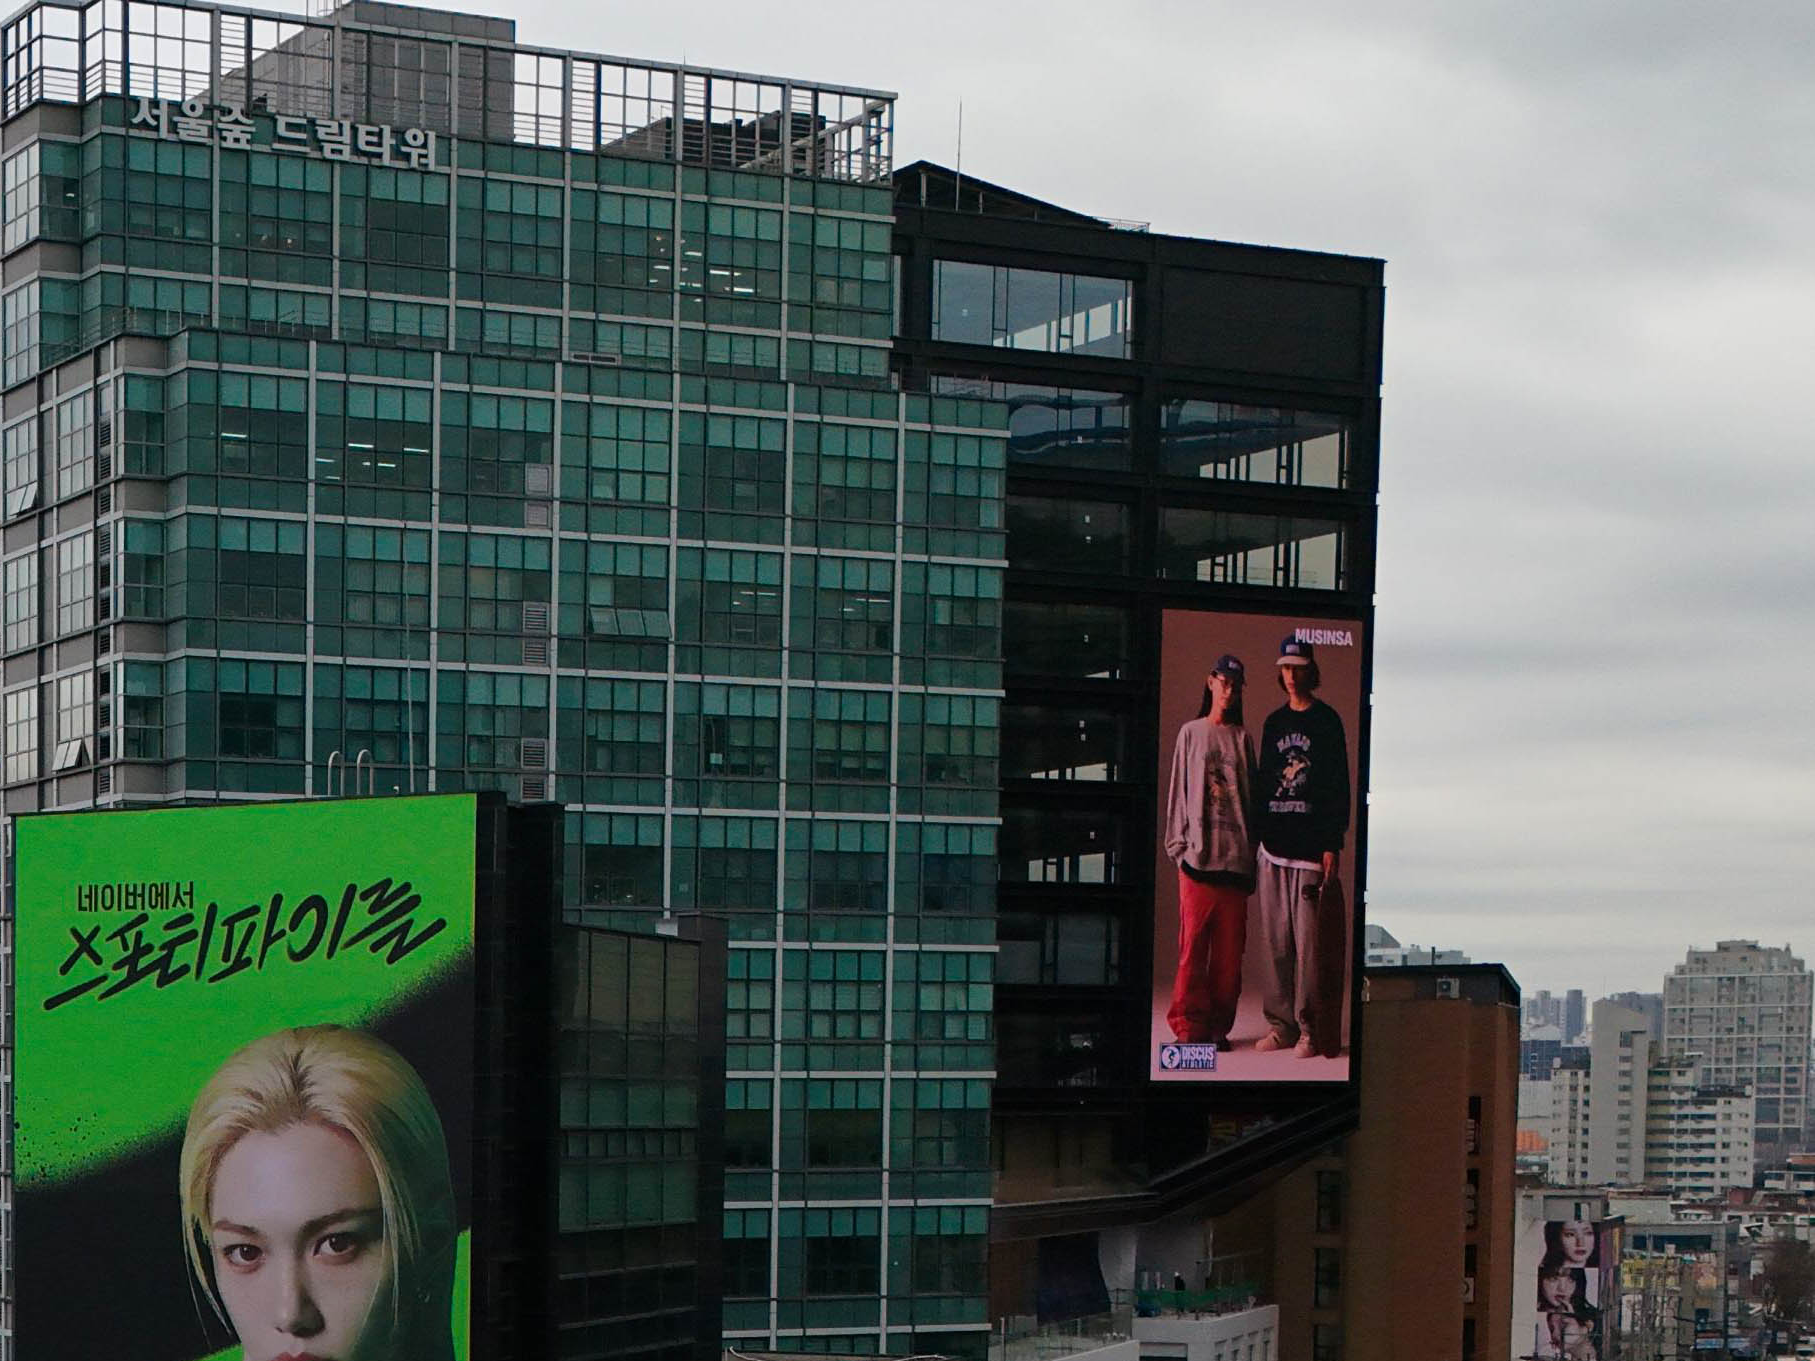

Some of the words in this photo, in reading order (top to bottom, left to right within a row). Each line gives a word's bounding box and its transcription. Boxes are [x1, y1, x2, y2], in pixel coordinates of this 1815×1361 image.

[132, 97, 256, 149] 서울숲
[272, 115, 436, 171] 드림타워
[1295, 628, 1353, 647] MUSINSA
[76, 881, 195, 914] 네이버에서
[43, 876, 448, 1011] 스포티파이를
[1182, 1046, 1214, 1060] DISCUS
